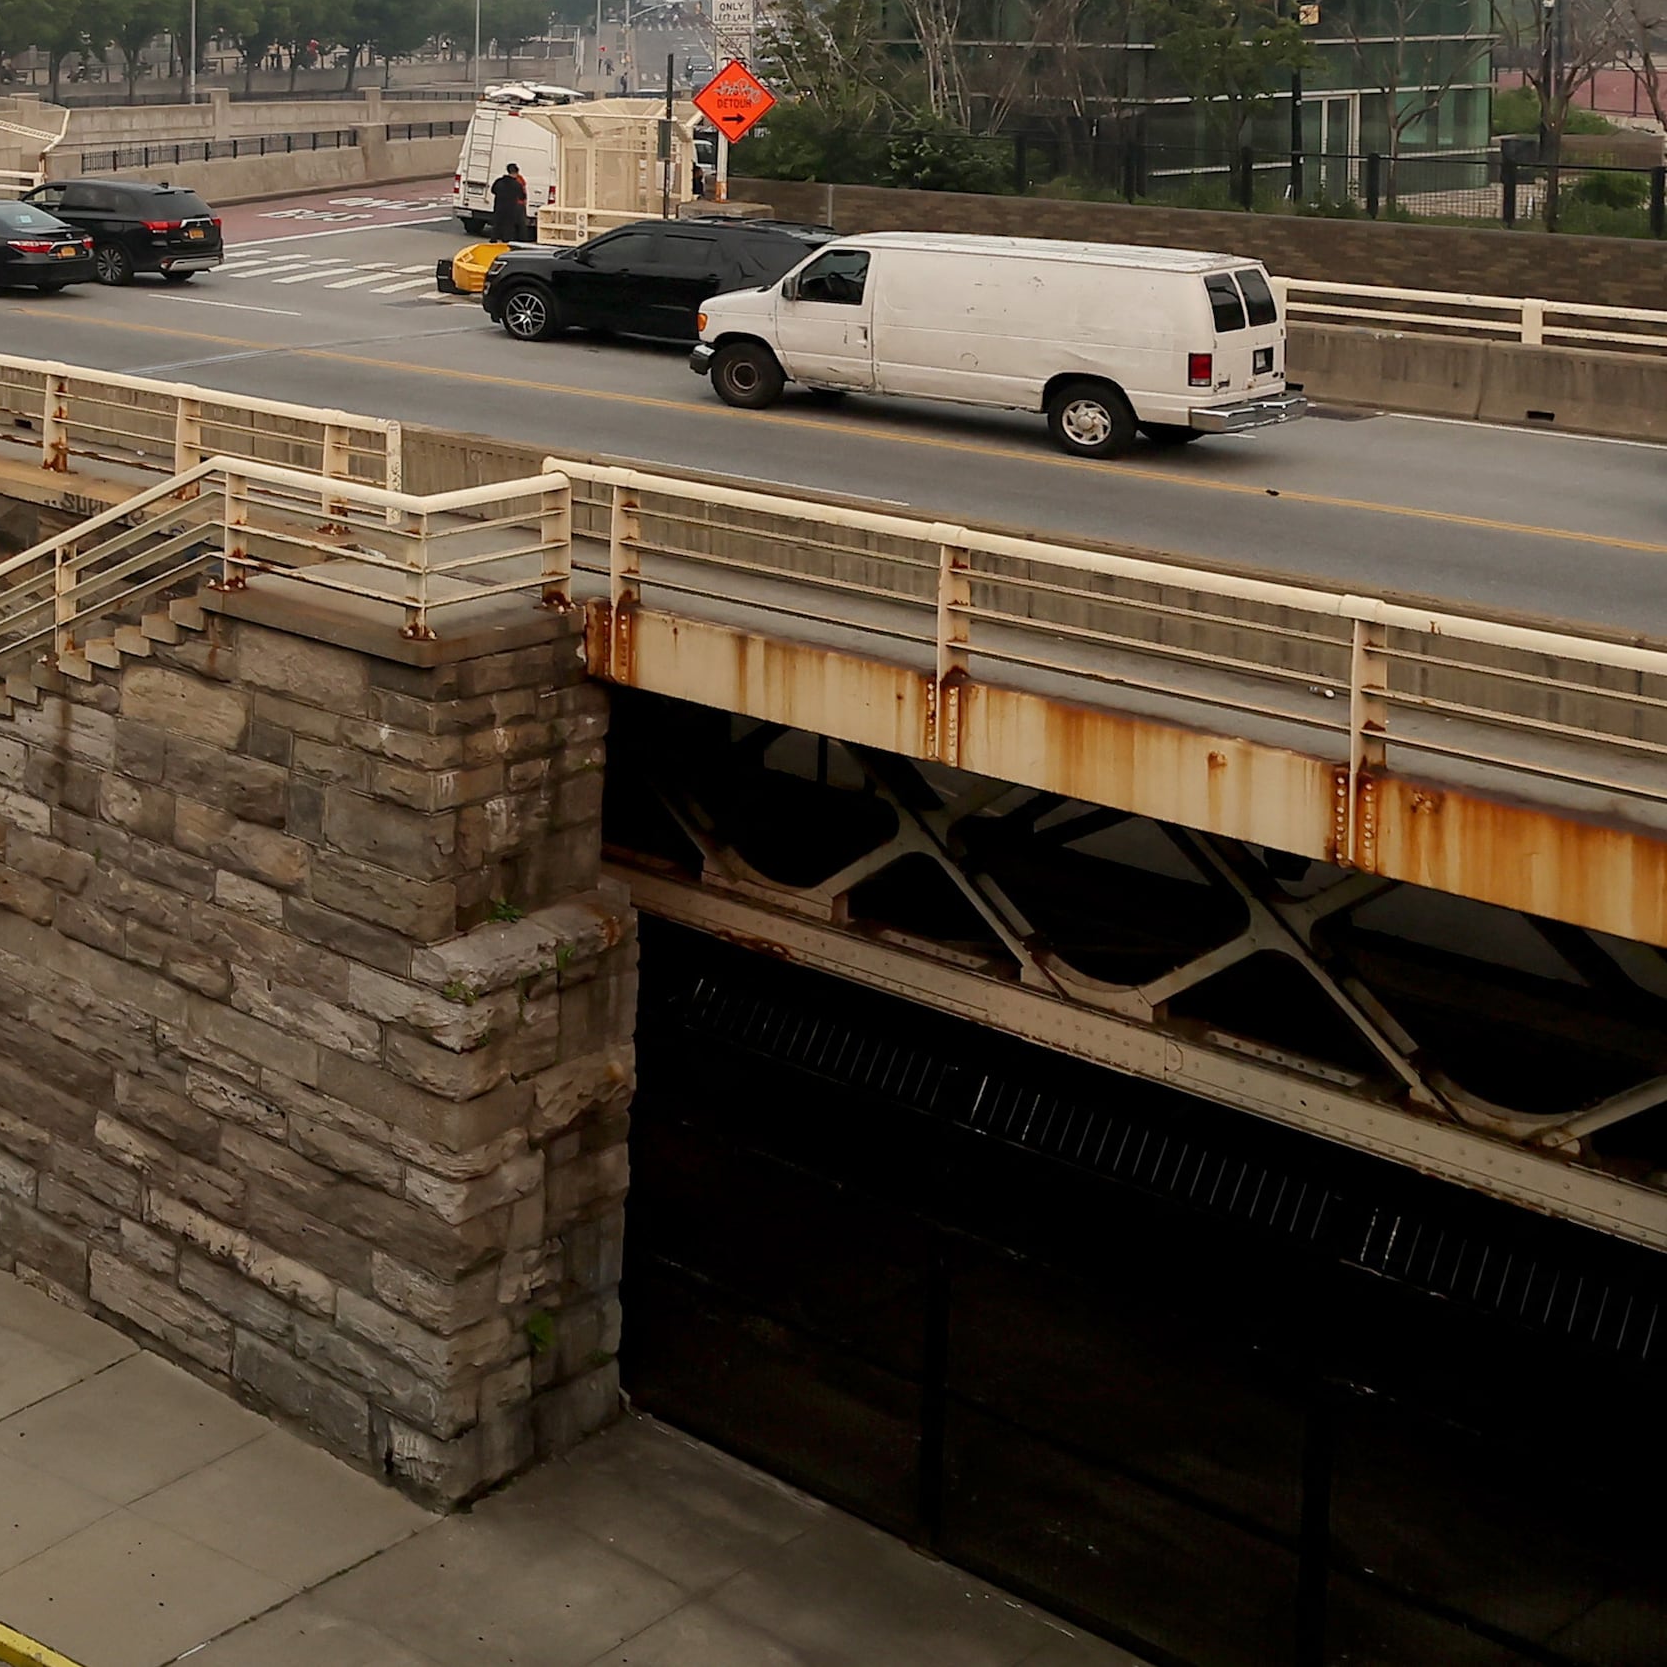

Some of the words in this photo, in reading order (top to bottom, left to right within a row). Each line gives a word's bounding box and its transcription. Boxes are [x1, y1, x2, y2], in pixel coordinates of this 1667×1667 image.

[719, 2, 744, 11] ONLY
[714, 13, 731, 22] LEFT
[733, 13, 750, 22] LANE
[717, 98, 752, 109] DETOUR
